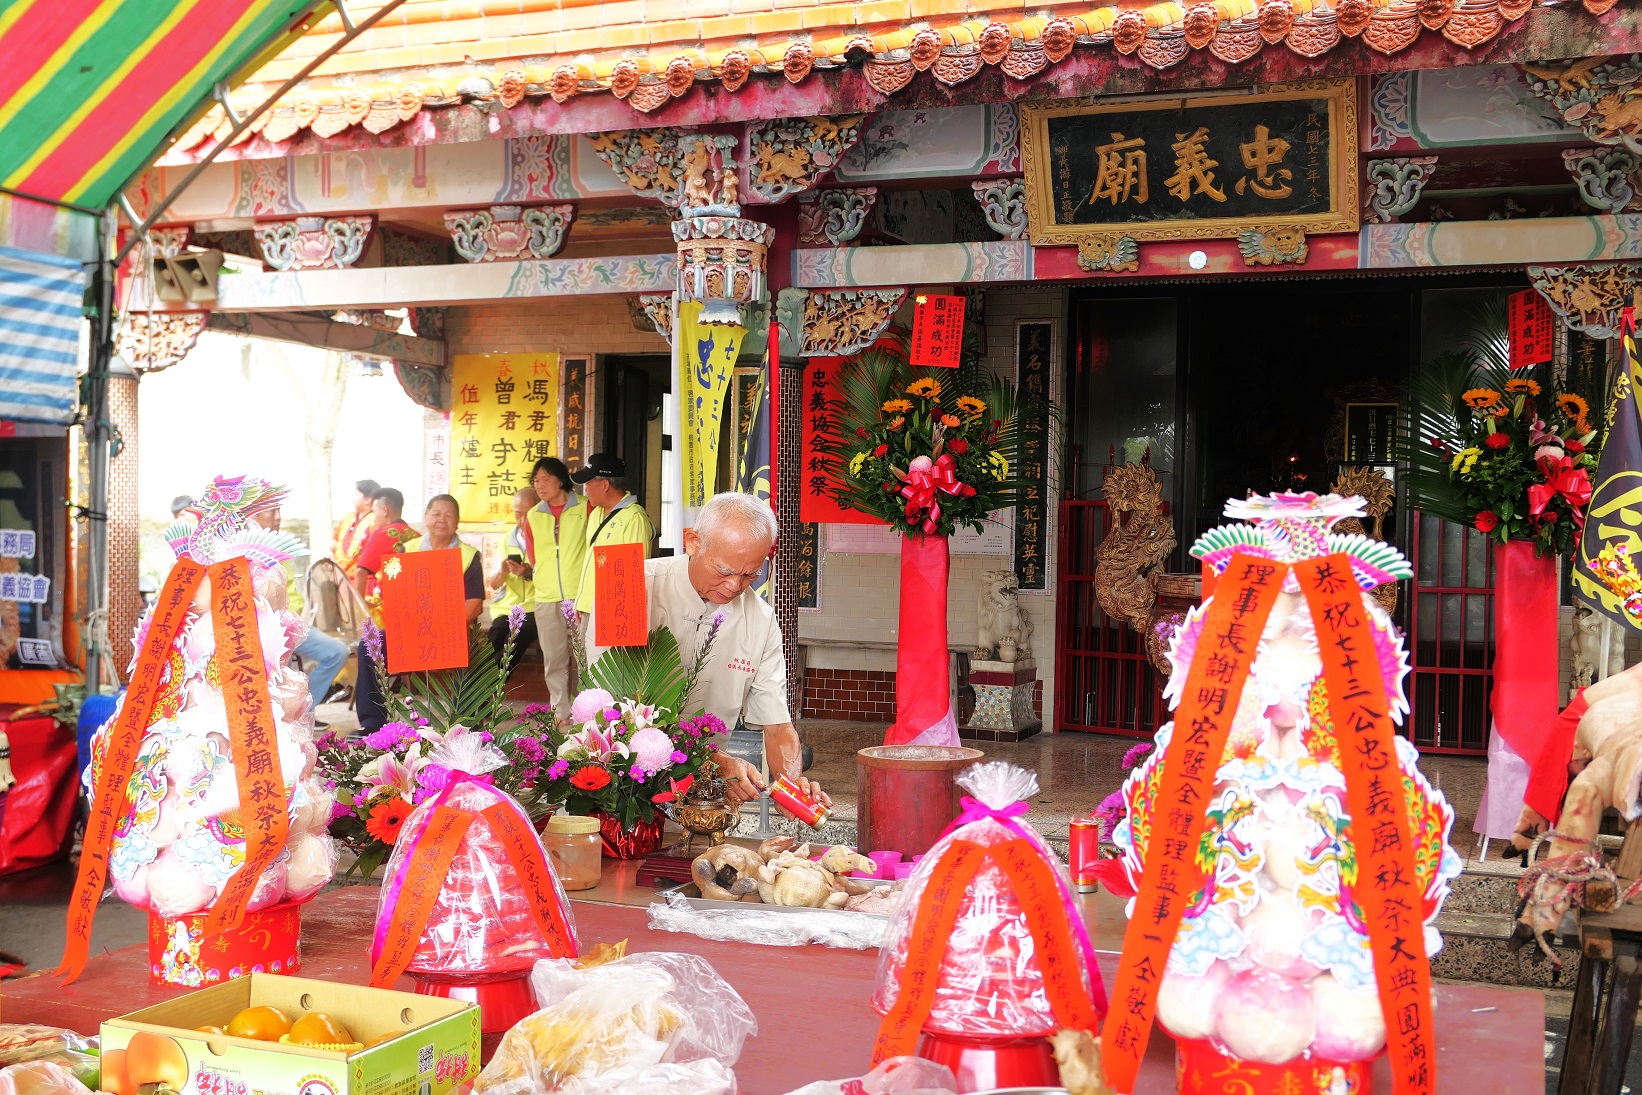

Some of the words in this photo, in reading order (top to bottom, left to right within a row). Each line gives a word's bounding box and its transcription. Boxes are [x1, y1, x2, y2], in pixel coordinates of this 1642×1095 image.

[1089, 124, 1293, 206] 忠義廟
[929, 298, 947, 357] 圓滿成功
[1522, 291, 1535, 355] 圓滿成功
[710, 338, 735, 452] 七十三公
[1367, 409, 1377, 462] 抗日烈士七十三
[0, 533, 35, 556] 務局
[0, 576, 47, 600] 義協會
[414, 567, 438, 663] 圓滿成功
[614, 558, 629, 640] 圓滿成功
[1311, 562, 1430, 1095] 恭祝七十三公忠義廟秋祭大典圓滿順
